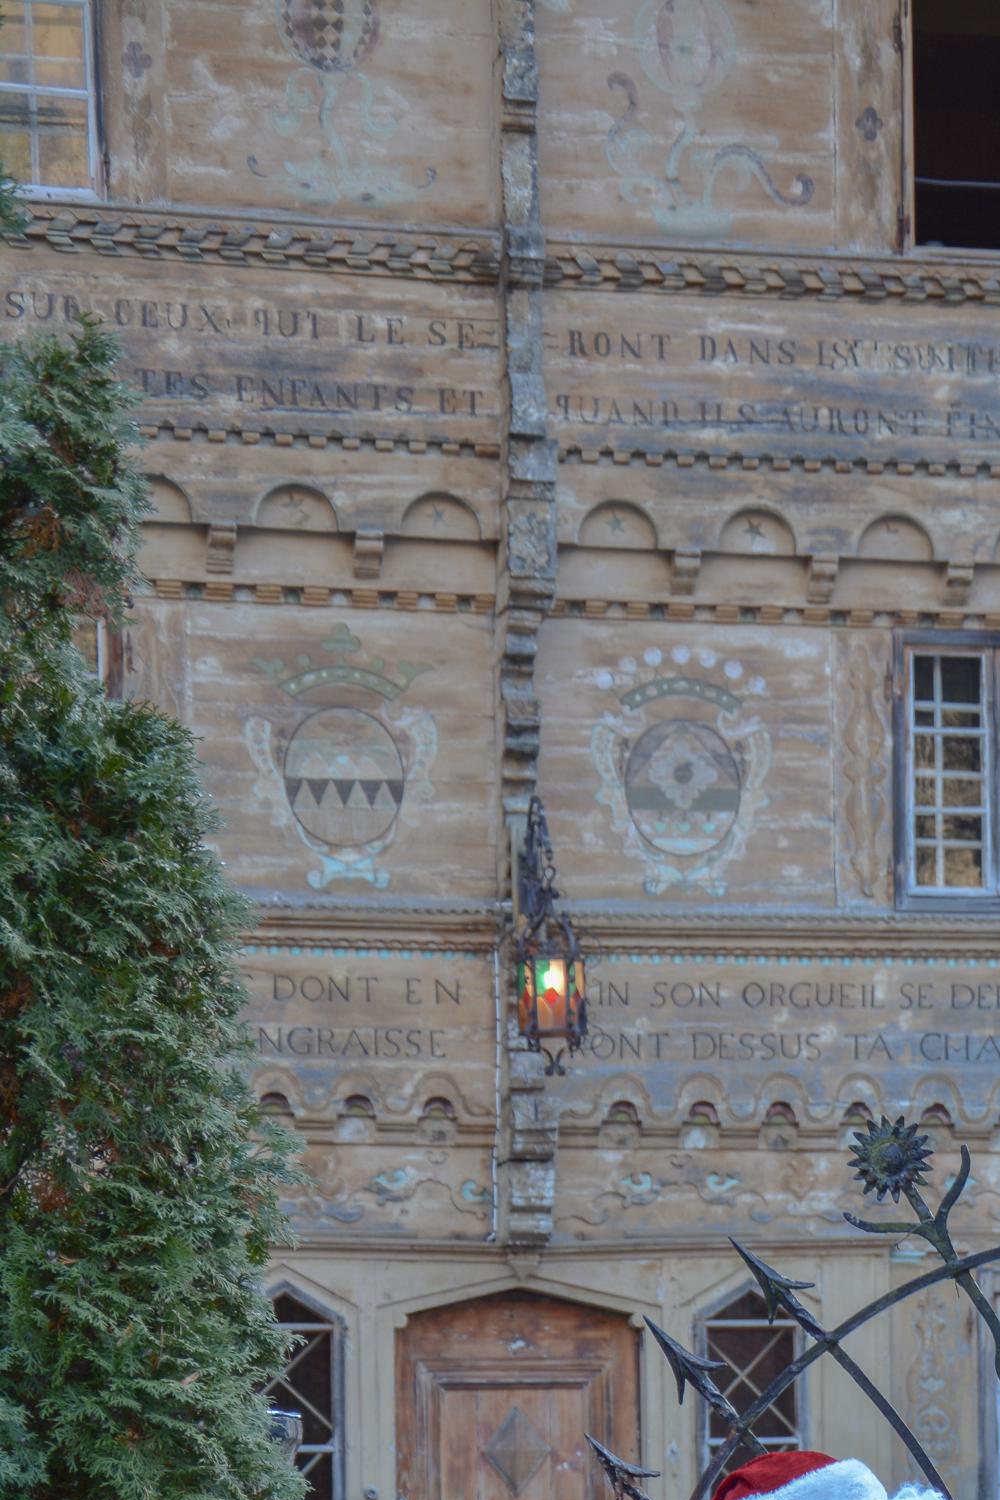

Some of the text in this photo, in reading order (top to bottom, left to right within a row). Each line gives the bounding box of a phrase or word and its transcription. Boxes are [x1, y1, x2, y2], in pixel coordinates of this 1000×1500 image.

[356, 314, 404, 345] LE
[699, 333, 797, 366] DANS
[235, 374, 414, 413] ENFANTS
[438, 387, 485, 416] ET
[272, 974, 380, 1004] DONT
[404, 976, 462, 1006] EN
[649, 980, 722, 1009] SON
[740, 980, 886, 1012] ORGUEIL
[898, 981, 934, 1011] SE
[691, 1031, 823, 1062] DESSUS
[843, 1033, 896, 1062] TA
